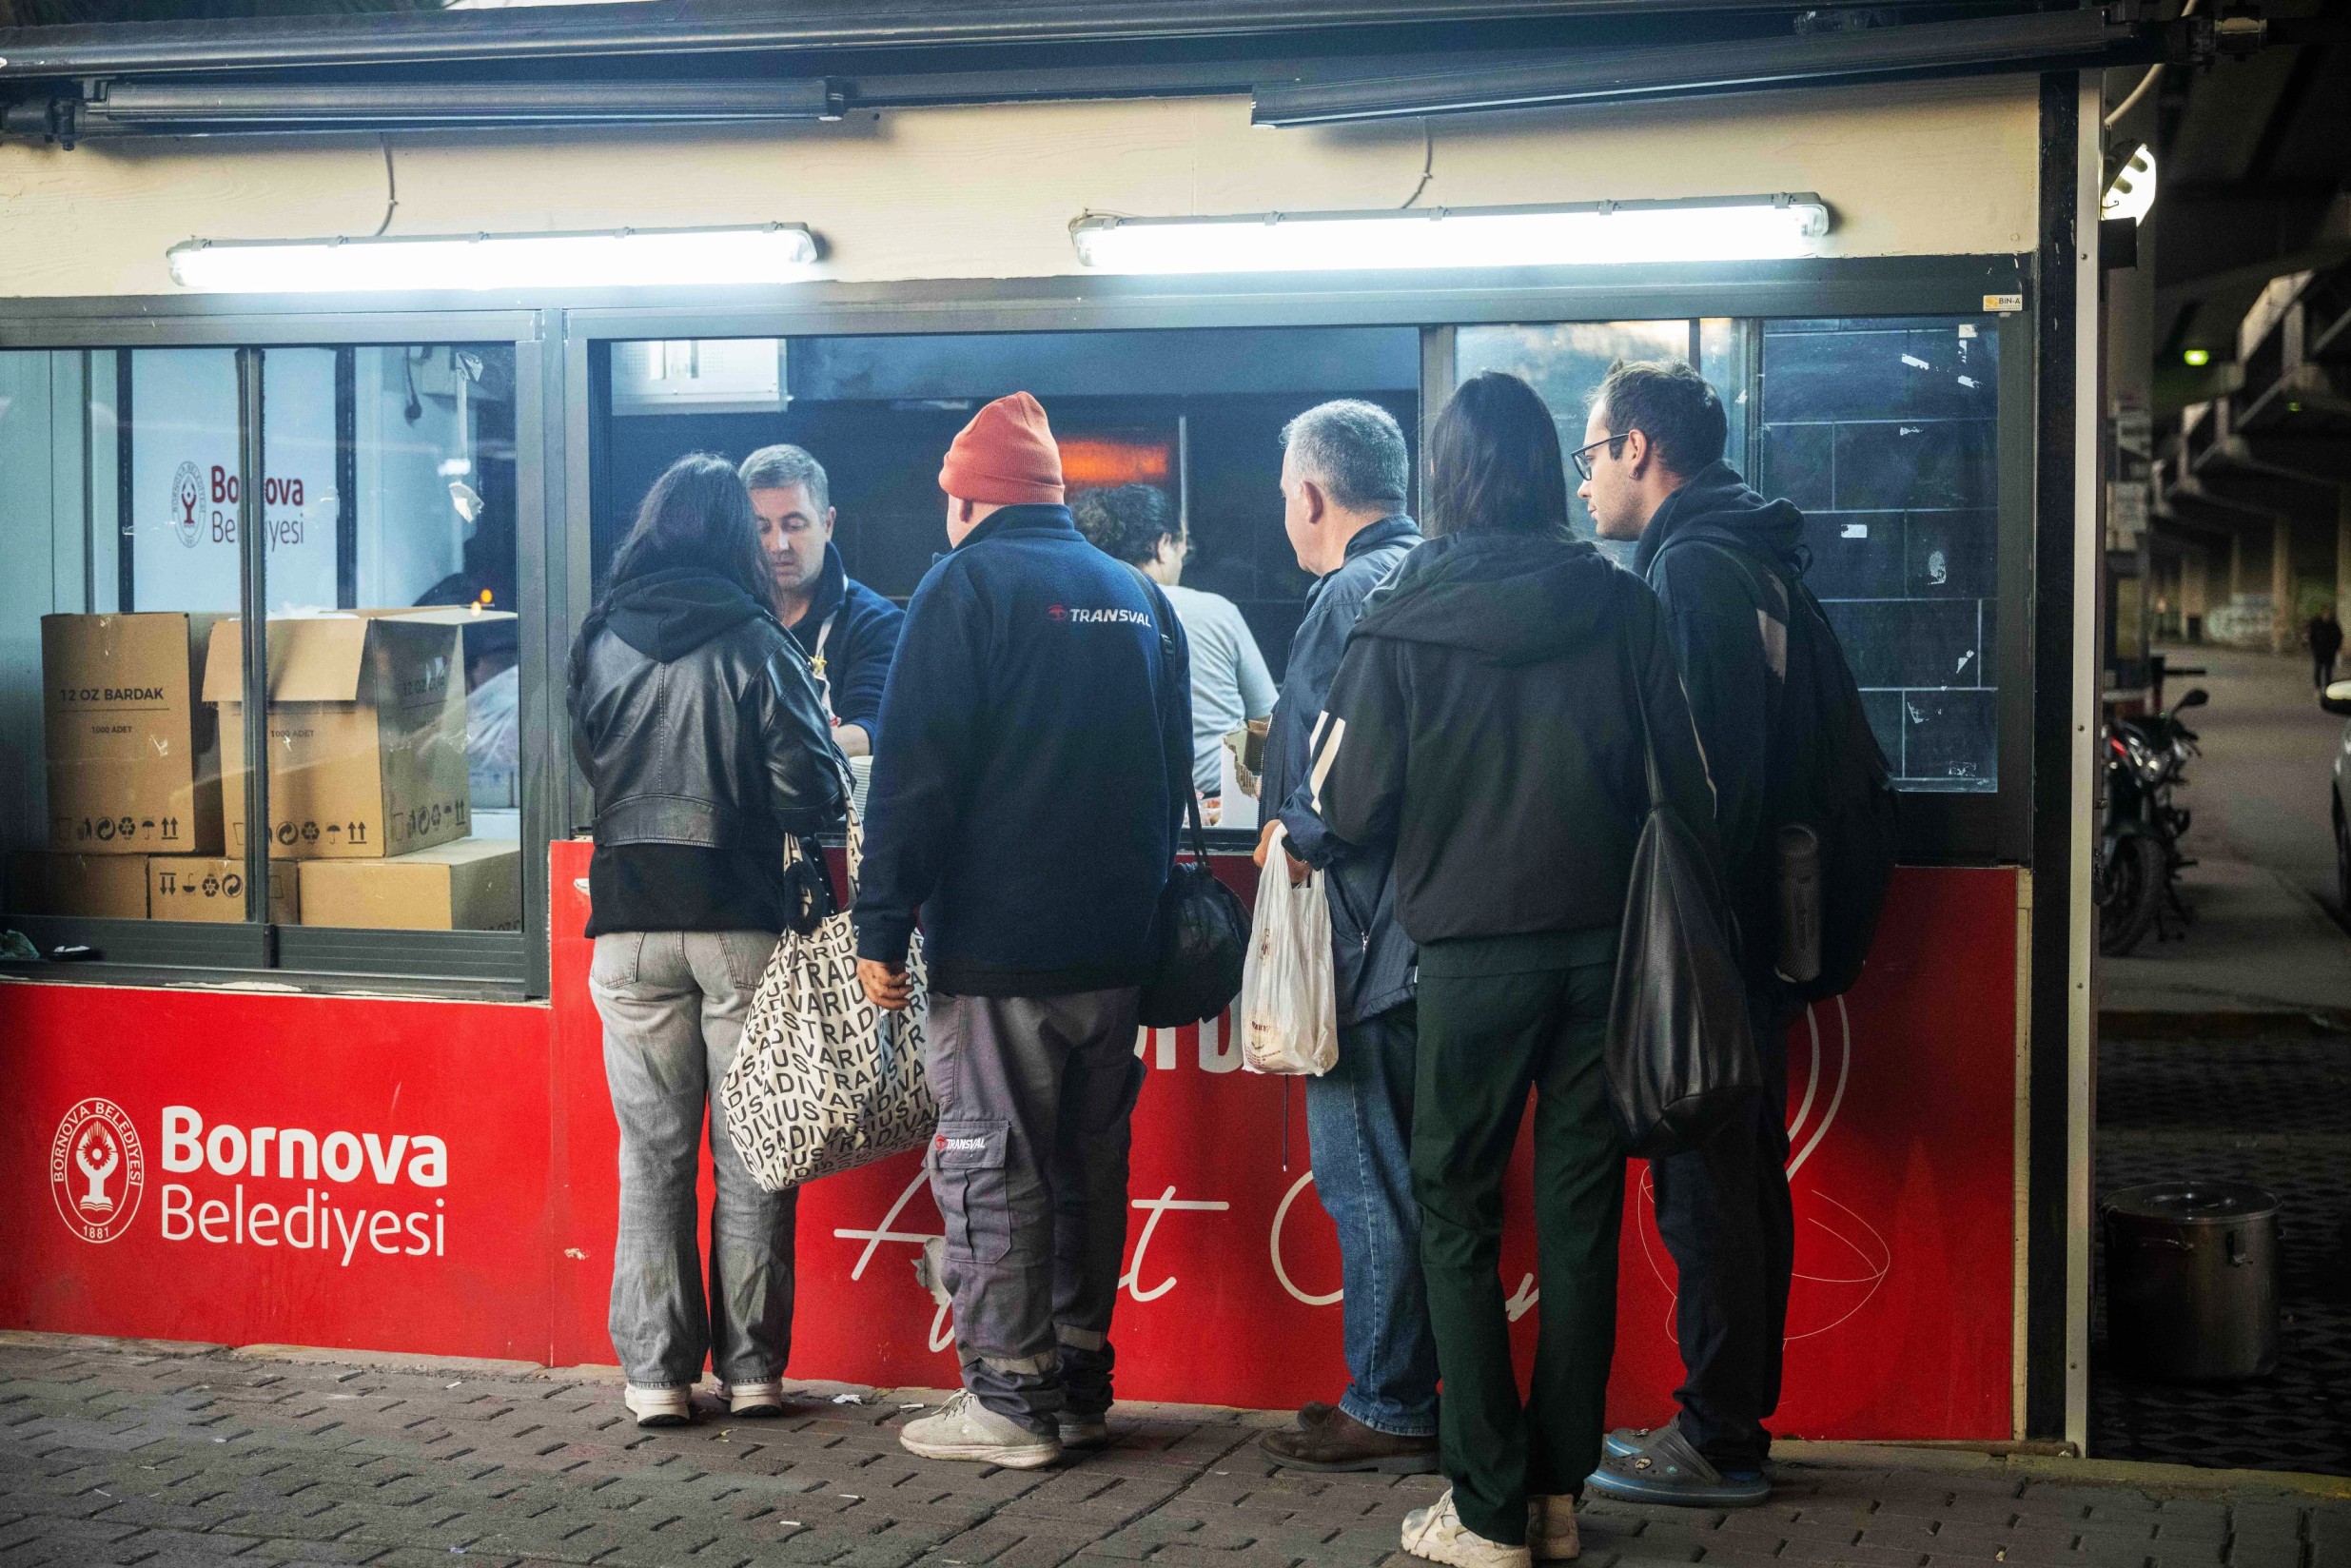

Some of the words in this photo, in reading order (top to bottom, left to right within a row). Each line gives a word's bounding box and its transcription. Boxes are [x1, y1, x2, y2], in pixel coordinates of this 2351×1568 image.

[211, 465, 304, 506] Boova
[1069, 608, 1152, 628] TRANSVAL
[60, 689, 75, 701] 12
[80, 688, 100, 701] OZ
[104, 687, 164, 700] BARDAK
[91, 725, 110, 734] 1000
[111, 725, 132, 734] ADET
[292, 730, 314, 738] ADET
[53, 1105, 90, 1183] BORNOVA
[162, 1105, 448, 1187] Bornova
[946, 1137, 986, 1150] TRANSVAL
[83, 1225, 110, 1240] 1881
[161, 1183, 445, 1267] Belediyesi
